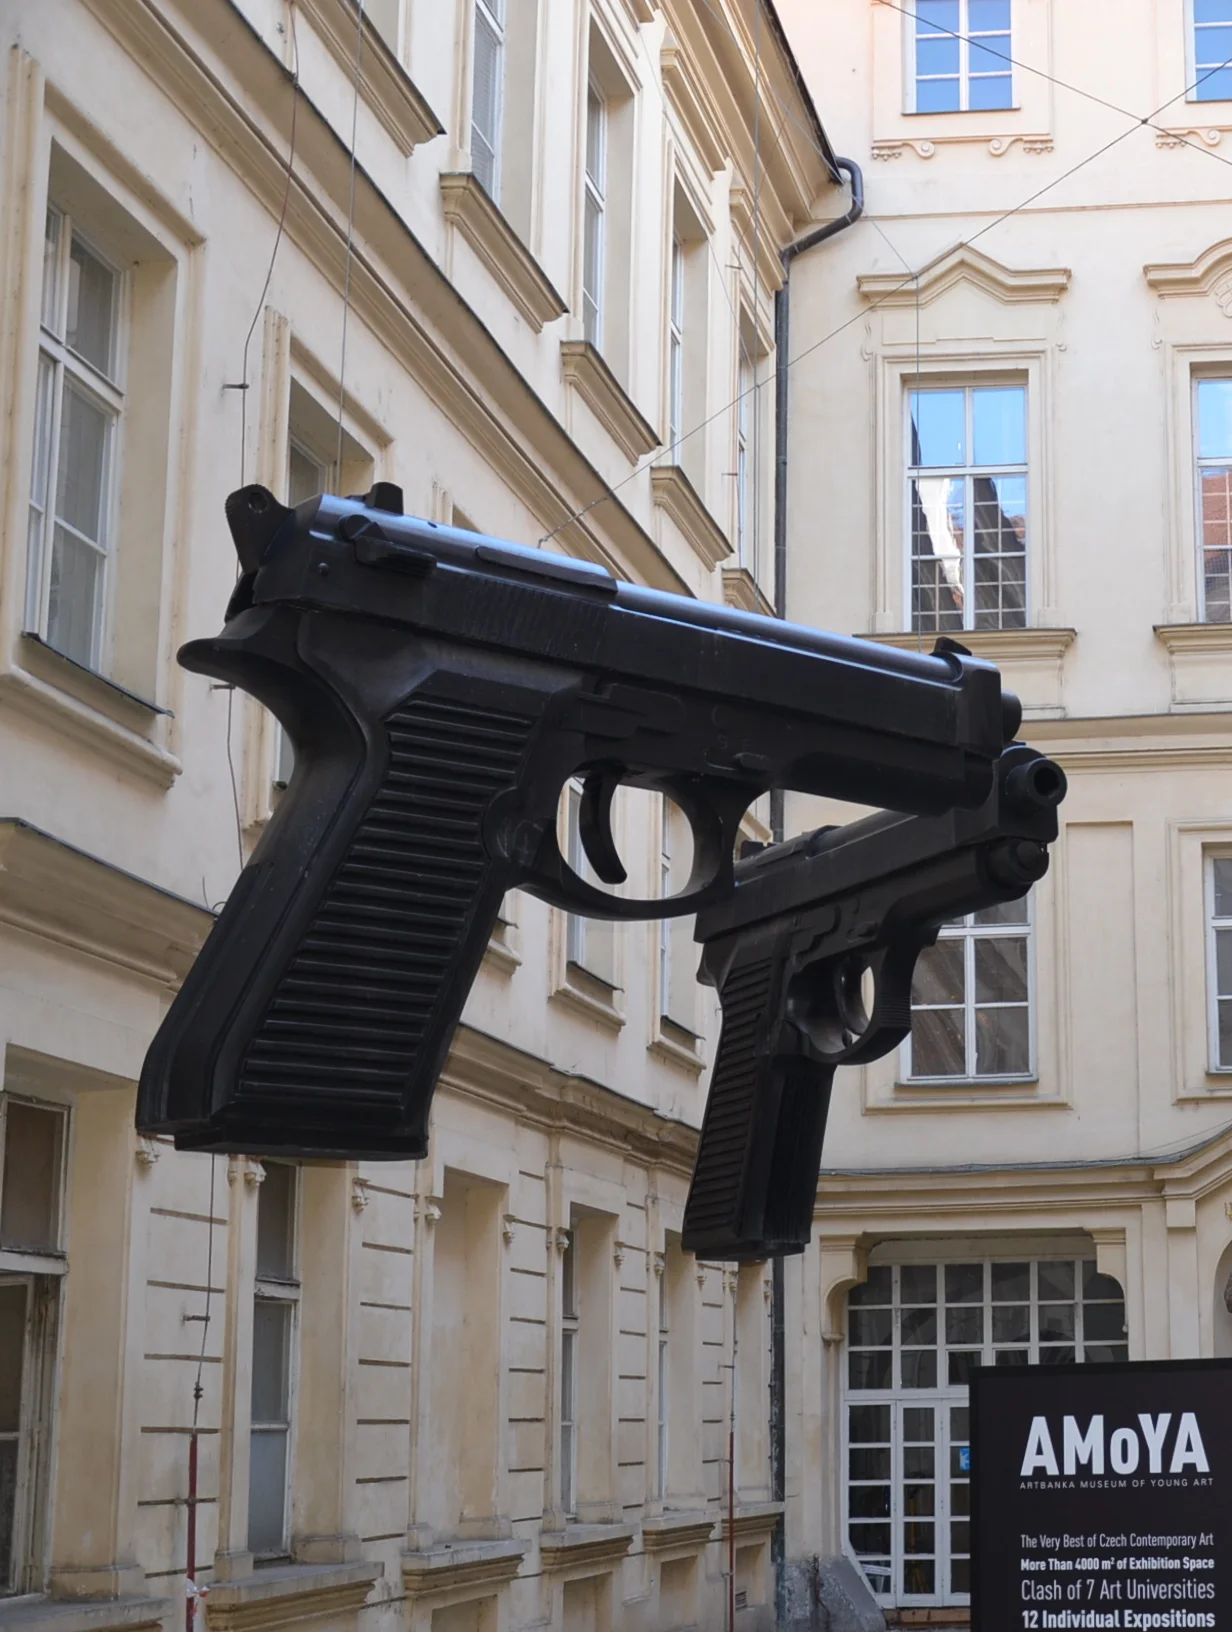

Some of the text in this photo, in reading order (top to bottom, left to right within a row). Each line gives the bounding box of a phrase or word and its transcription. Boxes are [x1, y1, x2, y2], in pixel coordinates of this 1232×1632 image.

[1020, 1412, 1211, 1476] AMoYA
[1019, 1477, 1214, 1490] ARTBANKA MUSEUM OF YOUNG ART
[1020, 1532, 1215, 1551] The Very Best of Czech Contemporary Art
[1020, 1558, 1047, 1571] More
[1047, 1558, 1074, 1571] Than
[1074, 1557, 1100, 1571] 4000
[1116, 1557, 1128, 1570] of
[1128, 1556, 1181, 1570] Exhibition
[1182, 1556, 1215, 1572] Space
[1021, 1577, 1216, 1601] Clash of 7 Art Universities
[1021, 1608, 1216, 1631] 12 Individual Expositions
